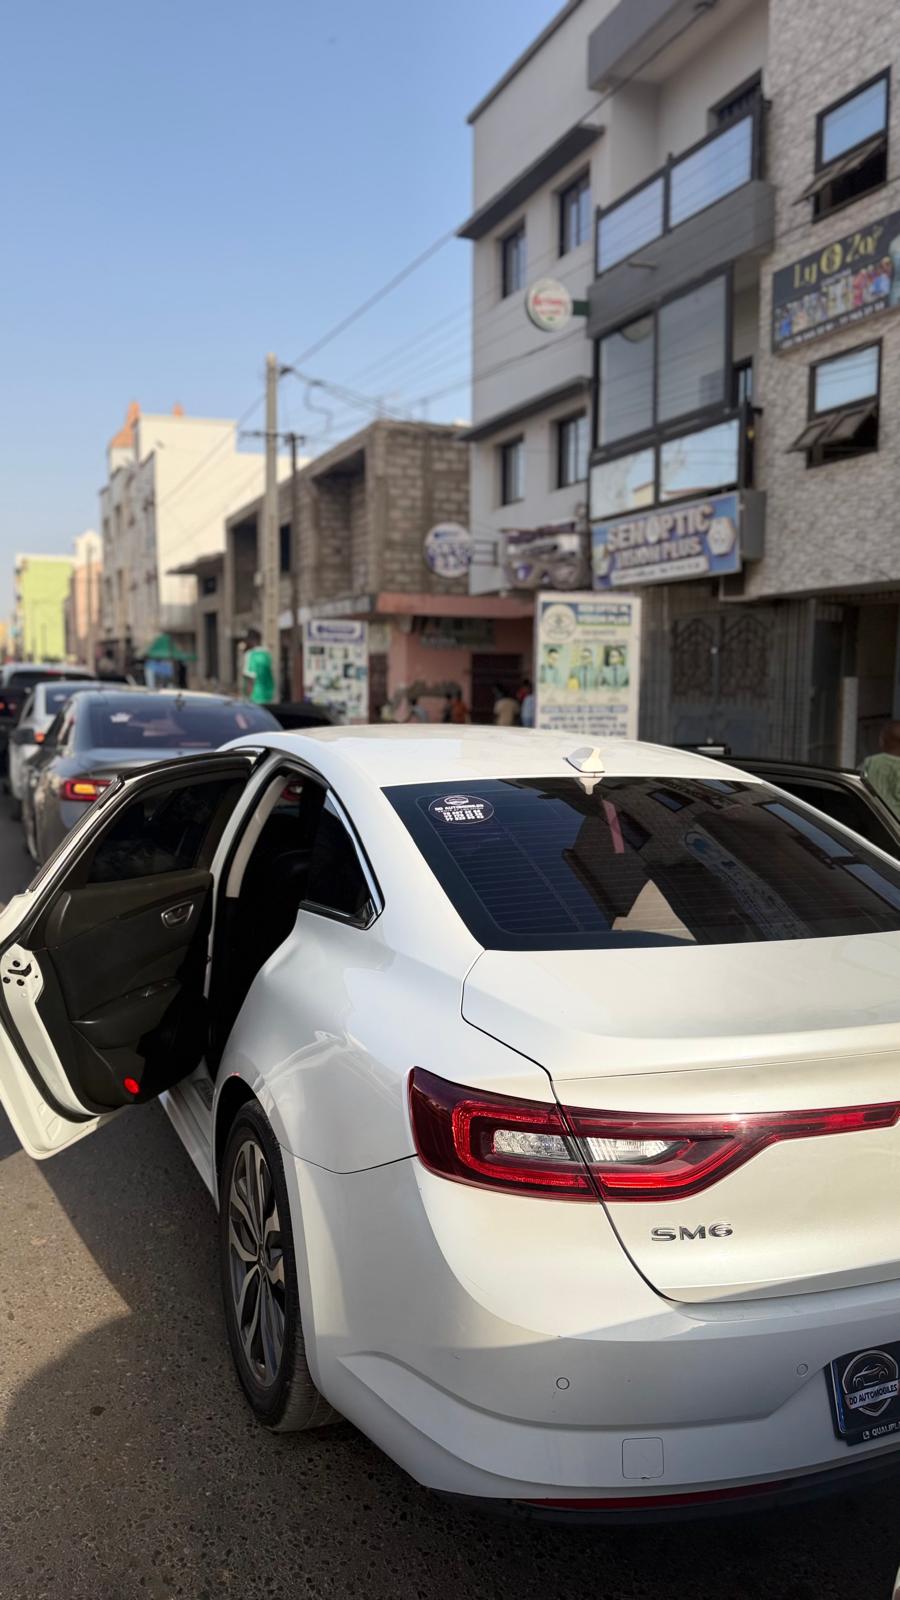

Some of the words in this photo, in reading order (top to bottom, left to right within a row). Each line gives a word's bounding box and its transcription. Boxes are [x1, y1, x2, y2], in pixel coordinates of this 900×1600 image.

[660, 536, 703, 562] PLUS
[651, 1221, 733, 1242] SM6
[849, 1396, 858, 1406] DD
[858, 1383, 898, 1402] AUTOMOBILES
